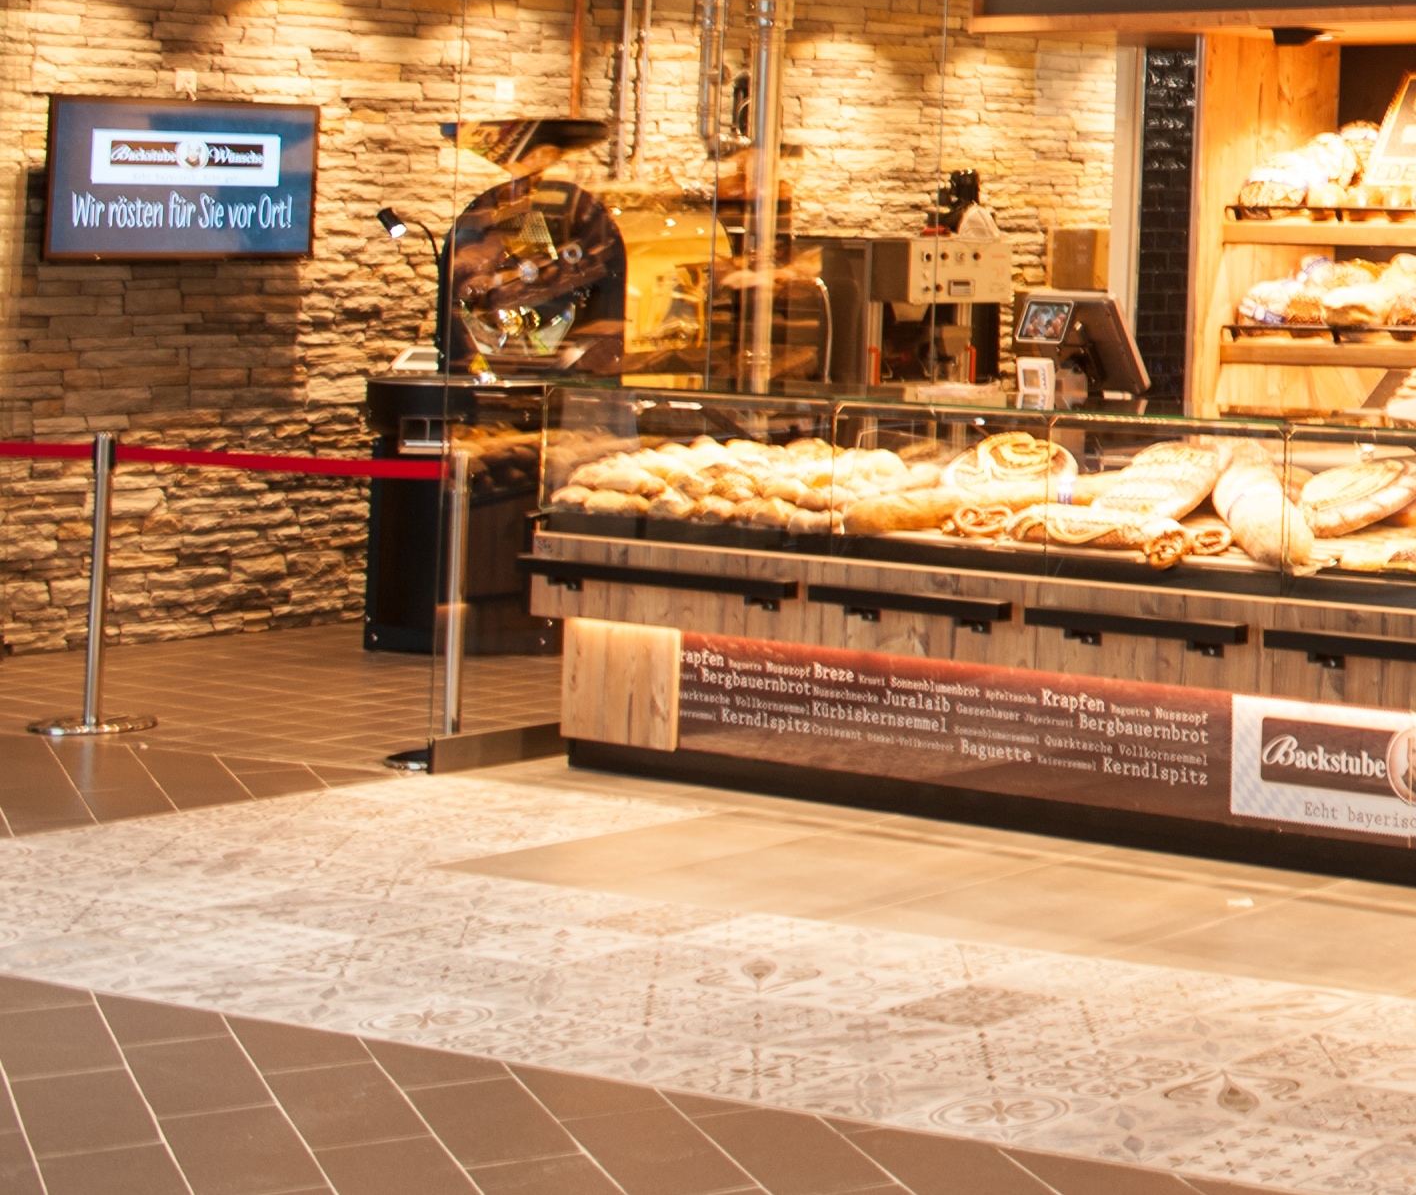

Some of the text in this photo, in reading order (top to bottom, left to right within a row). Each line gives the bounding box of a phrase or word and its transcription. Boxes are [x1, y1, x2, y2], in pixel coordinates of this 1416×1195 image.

[111, 143, 178, 163] Backstube
[71, 190, 293, 229] Wir rösten für Sie vor Ort!
[700, 665, 812, 695] Bergbauernbrot
[882, 688, 951, 713] Juralaib
[955, 701, 1021, 722] Gassenhauer
[1078, 711, 1209, 745] Bergbauernbrot
[765, 660, 812, 679] Nusszopf
[812, 661, 855, 683] Breze
[890, 674, 981, 698] Sonnenblumenbrot
[985, 689, 1038, 705] Apfeltasche
[1041, 687, 1106, 714] Krapfen
[1110, 702, 1151, 718] Baguette
[1154, 705, 1209, 726] Nusszopf
[721, 706, 811, 734] Kerndlspitz
[812, 719, 863, 741] Croissant
[960, 737, 1032, 763] Baguette
[1102, 755, 1209, 786] Kerndlspitz
[734, 694, 811, 716] Vollkornsemmel
[811, 699, 948, 733] Kürbiskernsemmel
[1044, 734, 1113, 755] Quarktasche
[1118, 742, 1209, 766] Vollkornsemmel
[1262, 733, 1387, 779] Backstube
[1304, 801, 1339, 821] Echt
